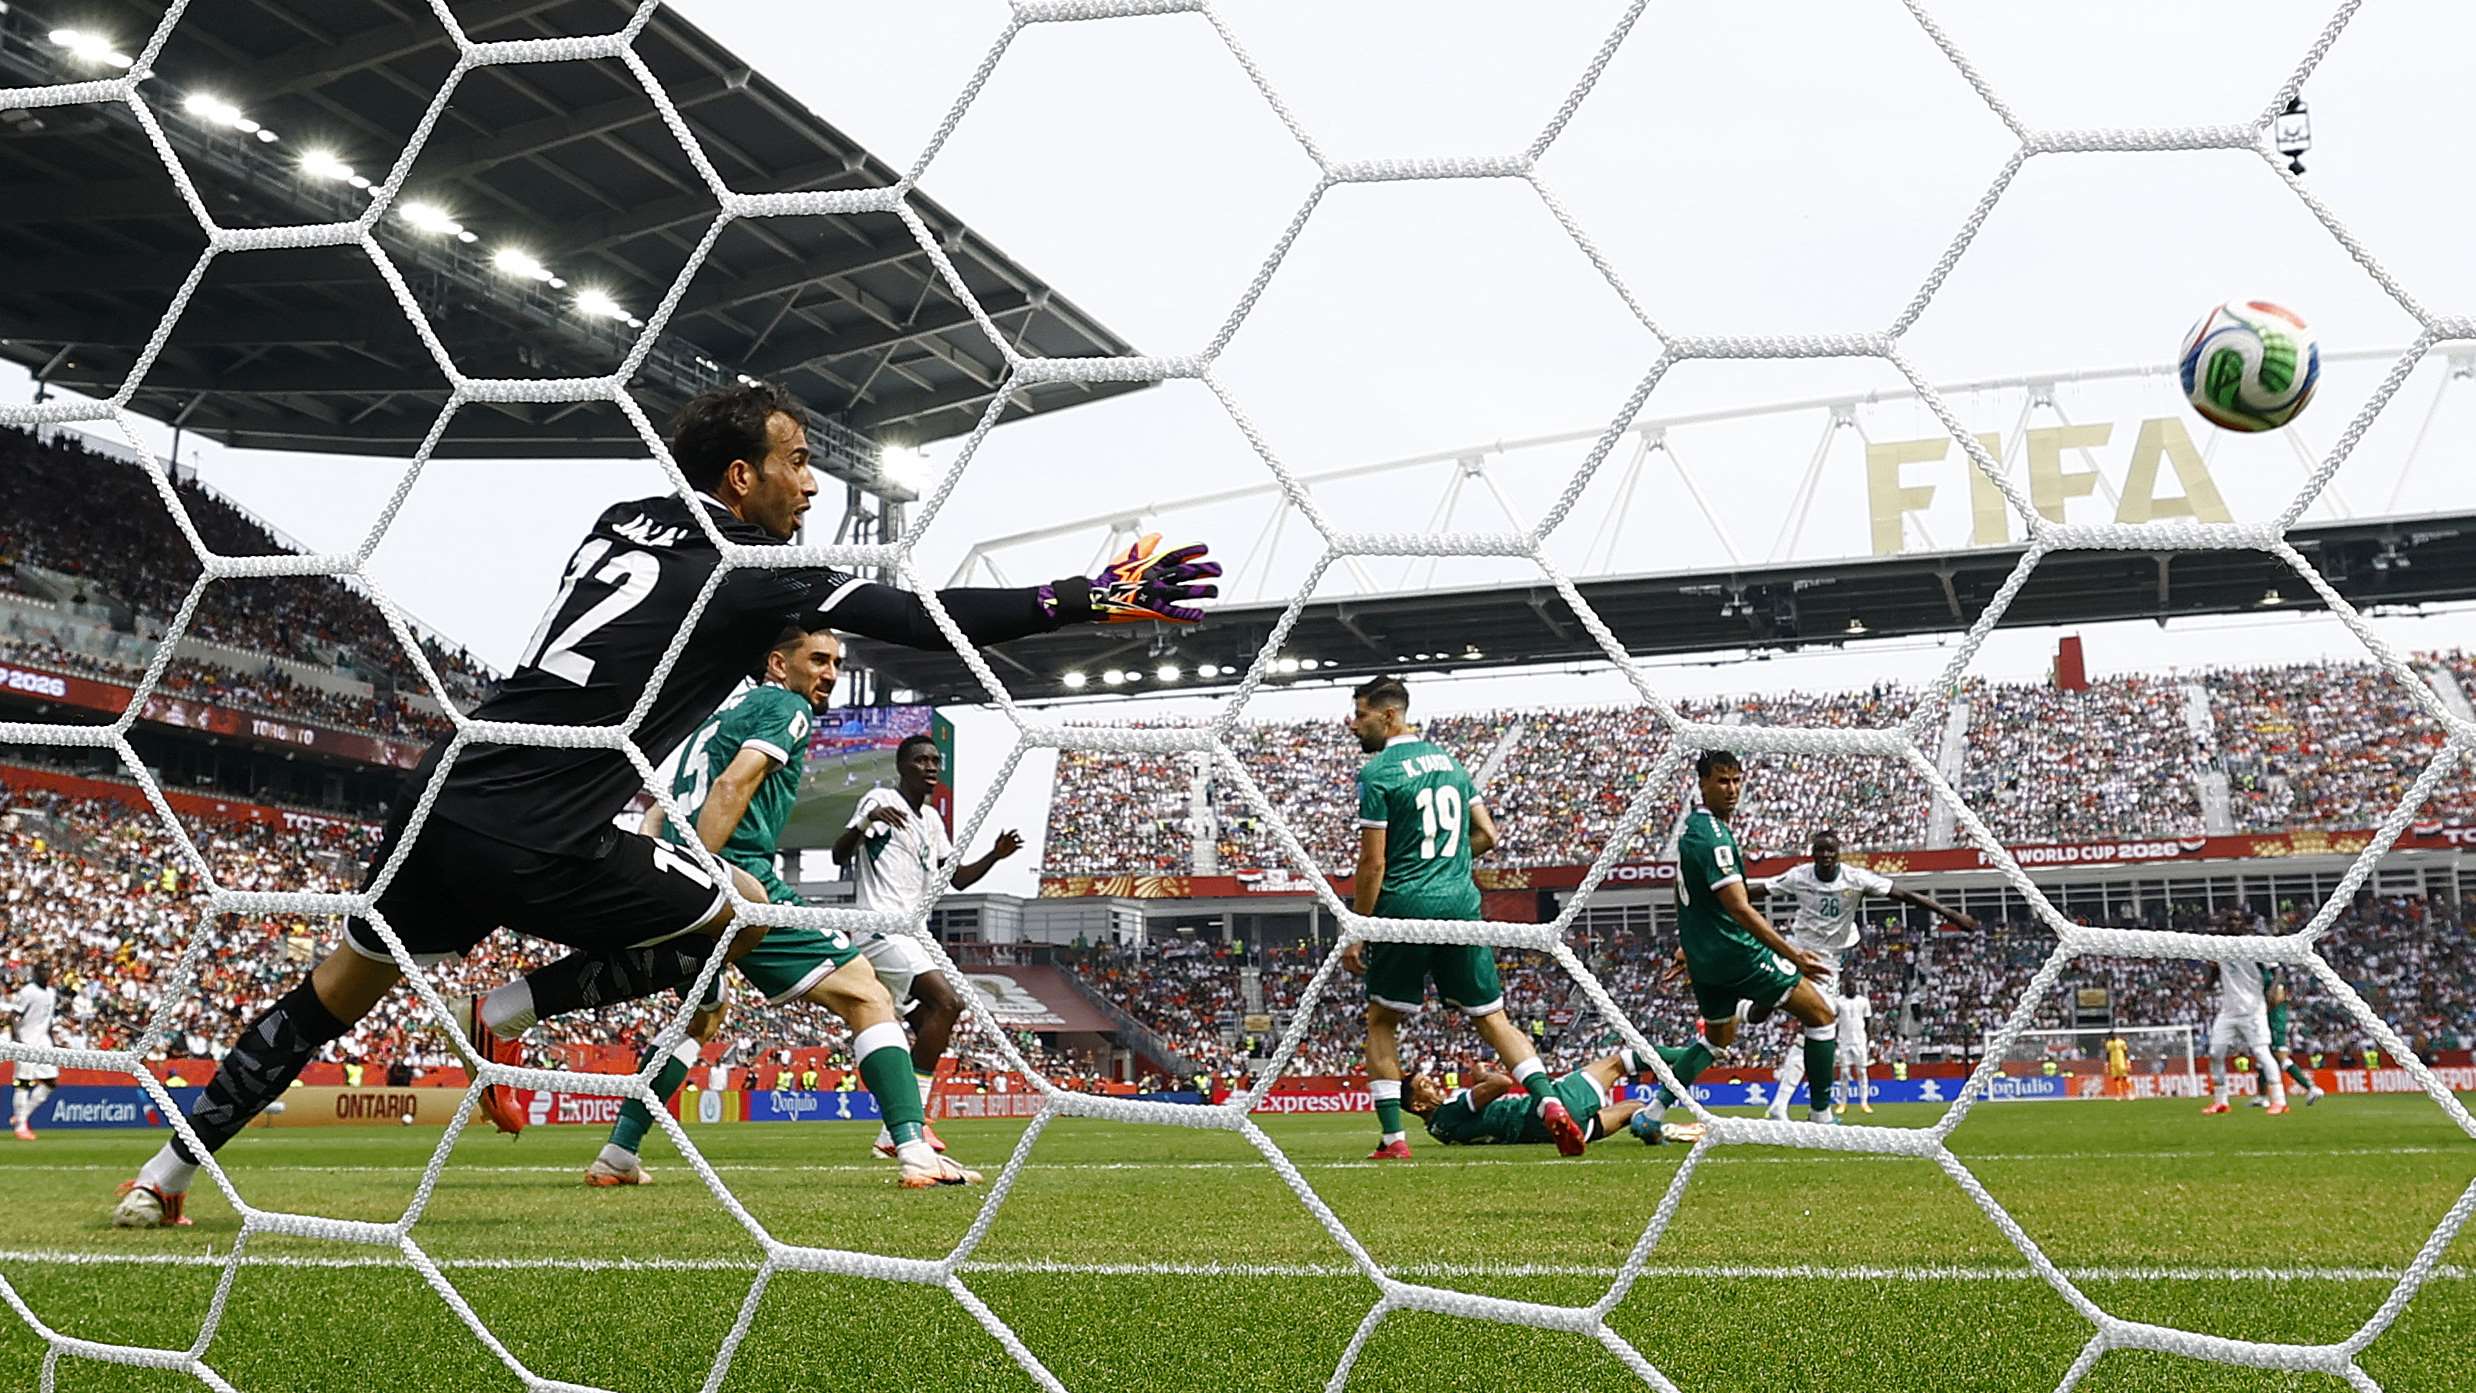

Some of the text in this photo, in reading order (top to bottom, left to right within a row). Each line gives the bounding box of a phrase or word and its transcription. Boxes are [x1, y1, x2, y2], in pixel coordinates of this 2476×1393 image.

[1865, 416, 2236, 555] FIFA
[519, 538, 661, 687] 12
[8, 670, 66, 697] 2026
[1416, 785, 1461, 860] 19
[2016, 846, 2079, 864] WORLD
[2081, 845, 2115, 861] CUP
[2117, 842, 2180, 859] 2026
[1820, 897, 1840, 918] 26
[1772, 953, 1797, 976] 6
[2335, 1070, 2368, 1093] THE
[51, 1094, 137, 1122] American
[336, 1093, 417, 1119] ONTARIO
